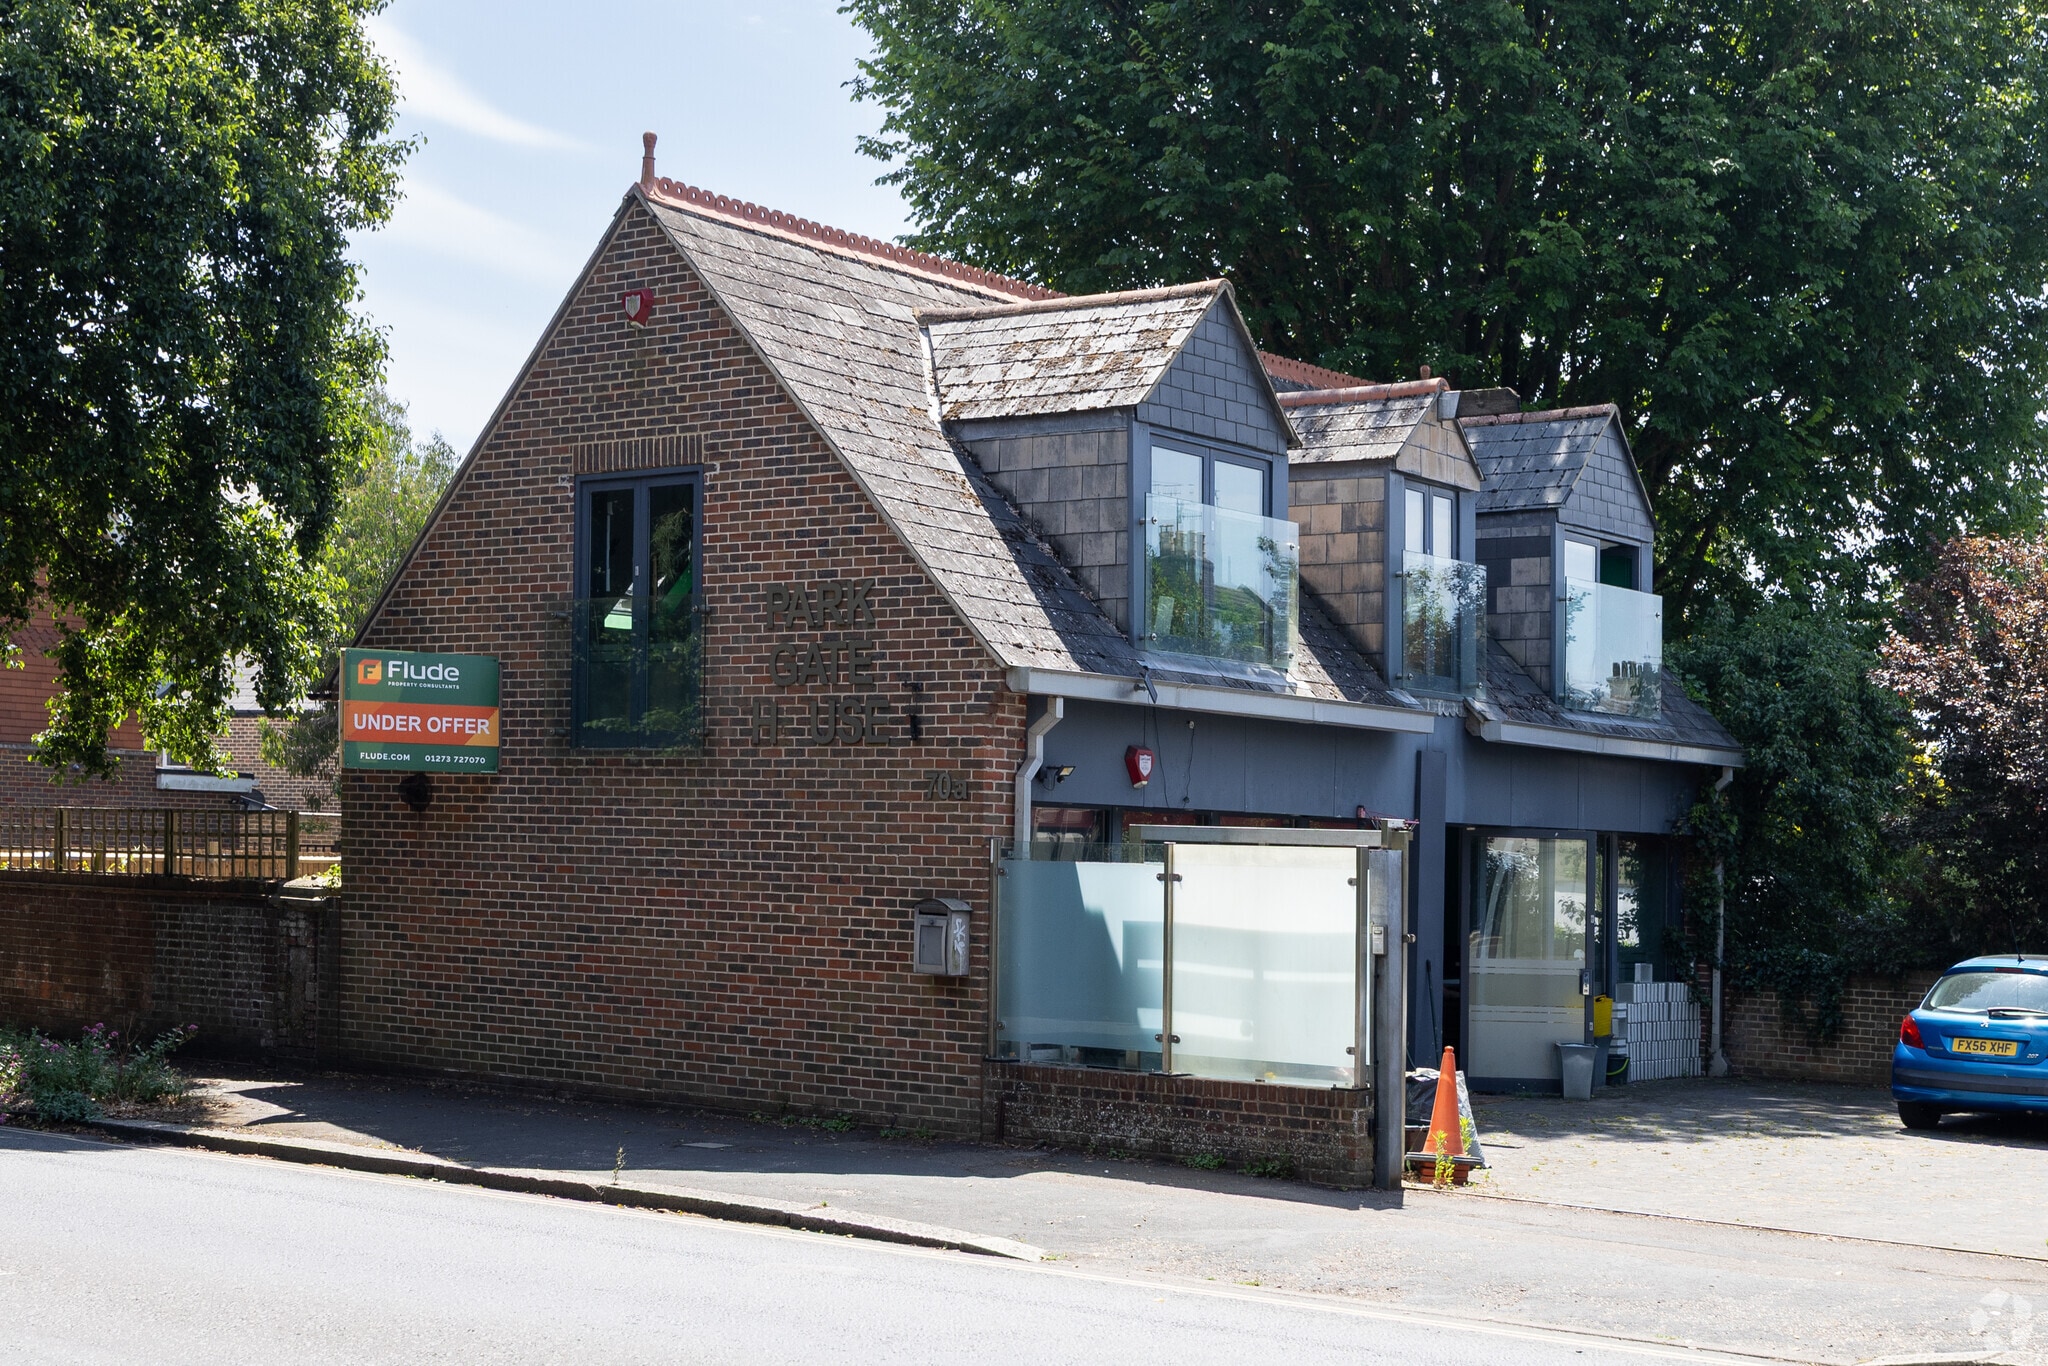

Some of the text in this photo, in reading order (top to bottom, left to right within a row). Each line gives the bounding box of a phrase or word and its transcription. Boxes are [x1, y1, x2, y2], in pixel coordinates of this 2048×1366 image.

[766, 579, 876, 629] PARK
[388, 660, 460, 682] Flude
[769, 639, 874, 687] GATE
[419, 682, 460, 690] CONSULTANTS
[353, 713, 490, 735] UNDER OFFER
[360, 752, 486, 764] FLUDE.COM 01273 727070
[925, 771, 968, 800] 70a
[1957, 1040, 2013, 1054] FX56 XHF
